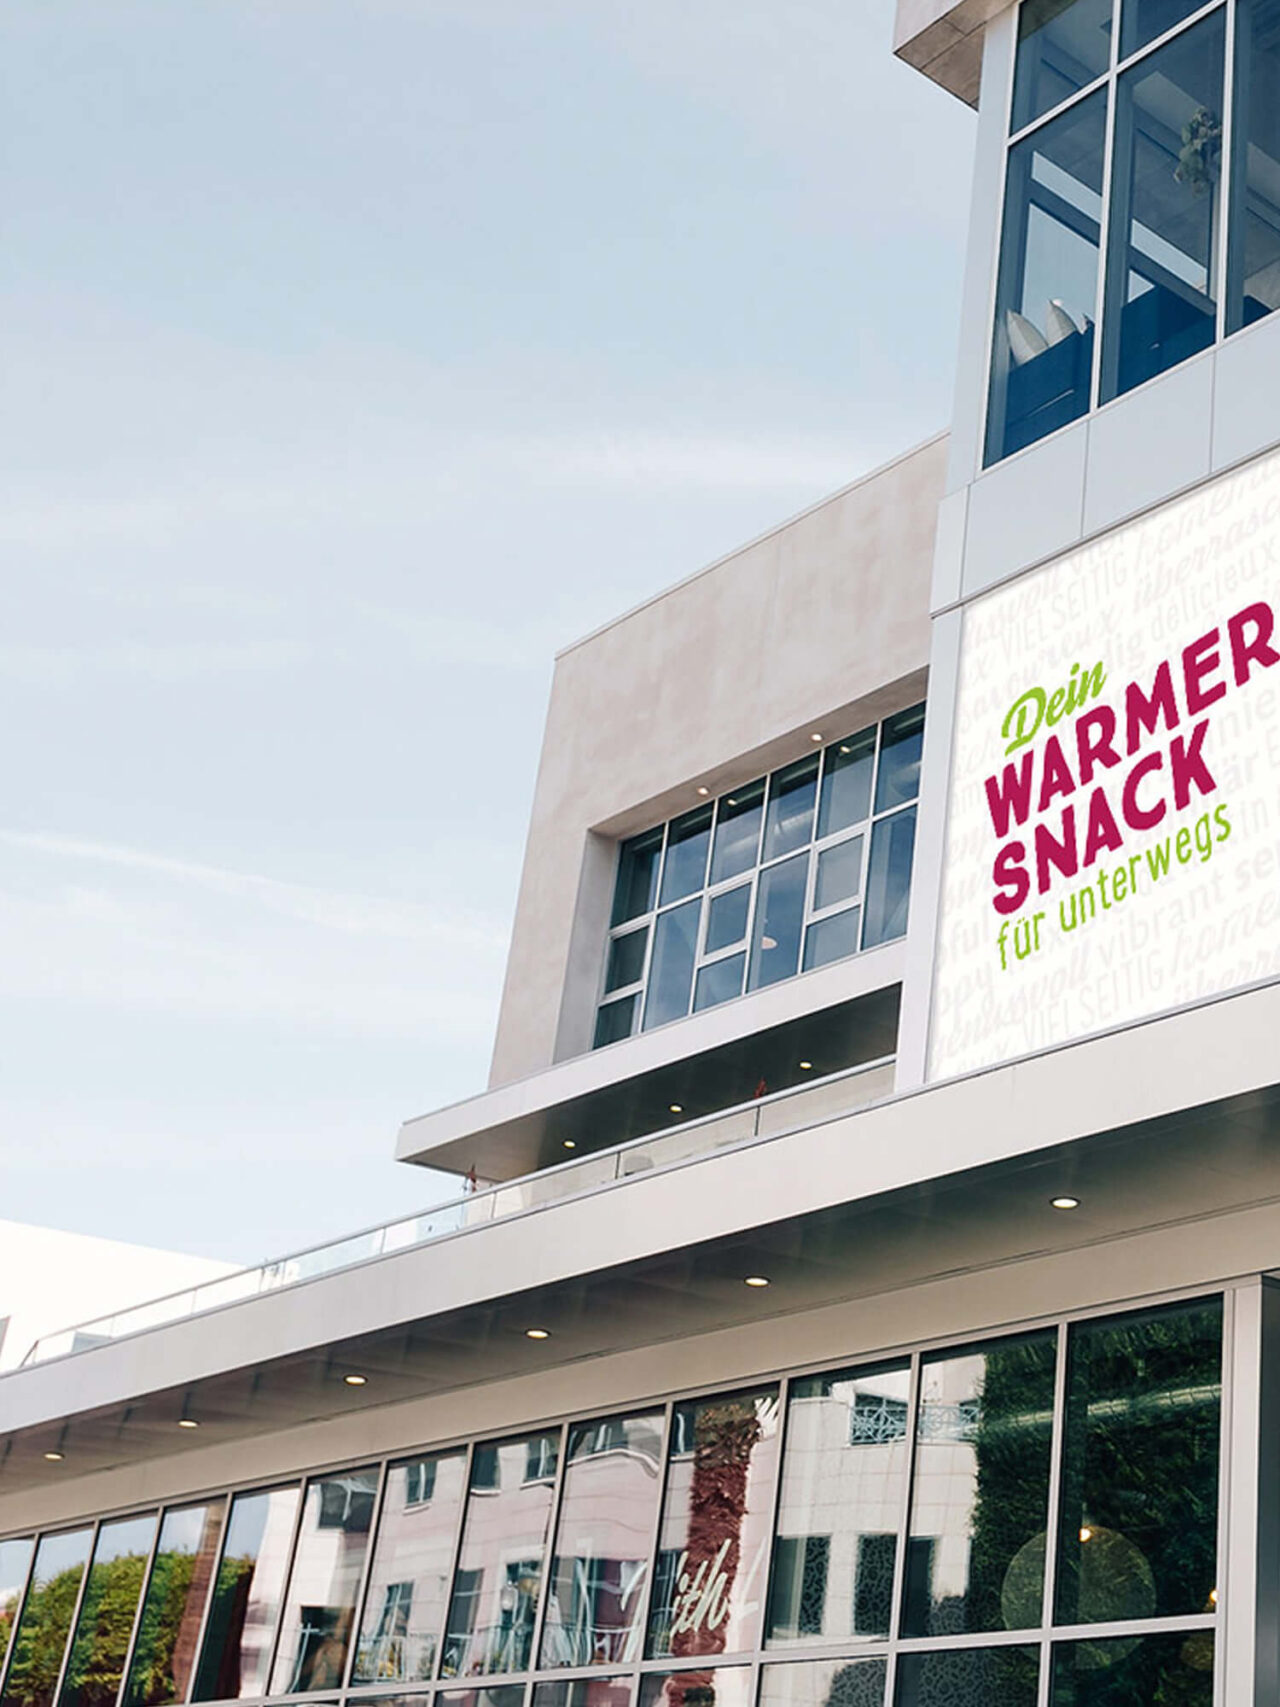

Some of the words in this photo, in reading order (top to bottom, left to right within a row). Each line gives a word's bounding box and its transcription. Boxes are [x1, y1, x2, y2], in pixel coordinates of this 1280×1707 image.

[985, 602, 1280, 839] WARMER
[1002, 661, 1107, 757] Dein
[993, 719, 1217, 915] SNACK
[997, 911, 1046, 971] für
[1060, 803, 1232, 932] unterwegs
